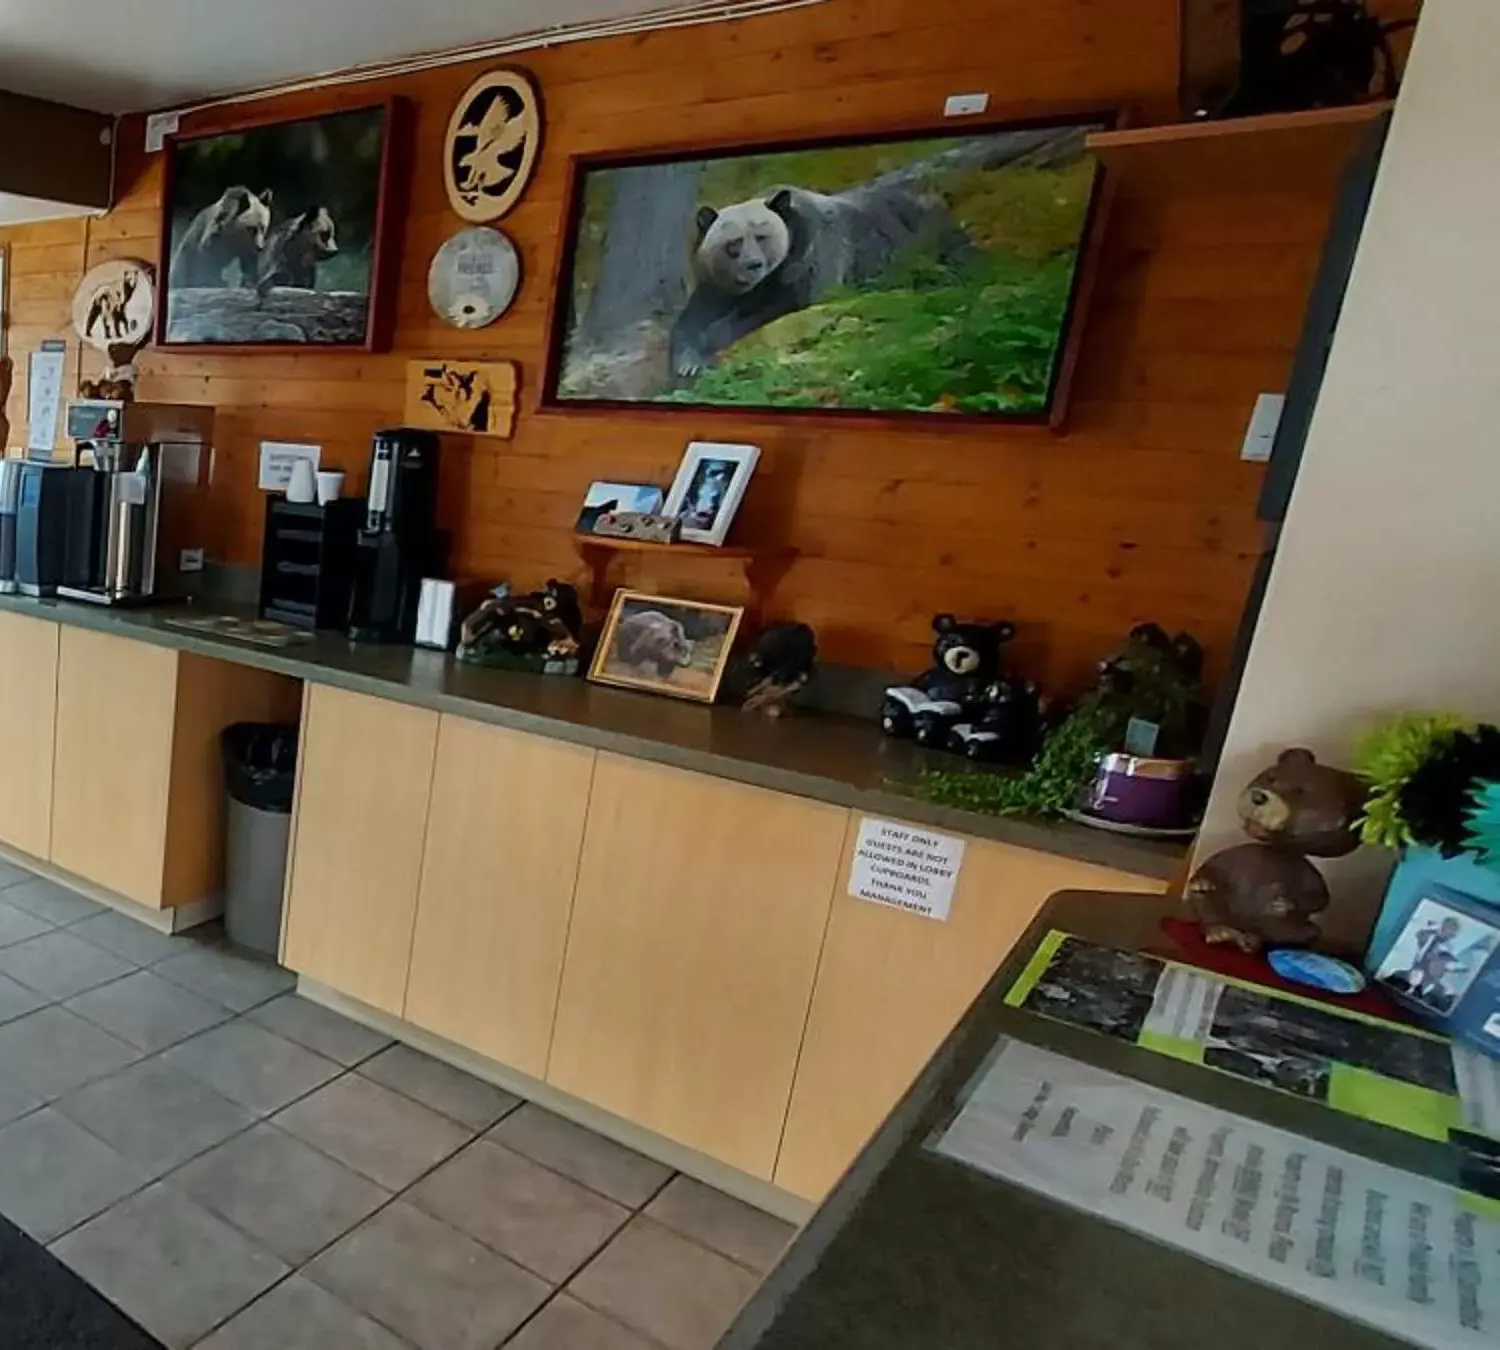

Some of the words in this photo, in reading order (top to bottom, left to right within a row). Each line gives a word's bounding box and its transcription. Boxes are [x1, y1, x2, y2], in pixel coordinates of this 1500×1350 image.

[880, 829, 909, 841] STAFF
[911, 835, 939, 848] ONLY
[858, 849, 905, 867] ALLOWED
[906, 861, 917, 869] IN
[920, 864, 952, 878] LOBBY
[865, 839, 902, 853] GUESTS
[905, 848, 924, 858] ARE
[927, 853, 948, 865] NOT
[860, 888, 932, 914] MANAGEMENT
[871, 878, 903, 893] THANK
[905, 888, 927, 899] YOU
